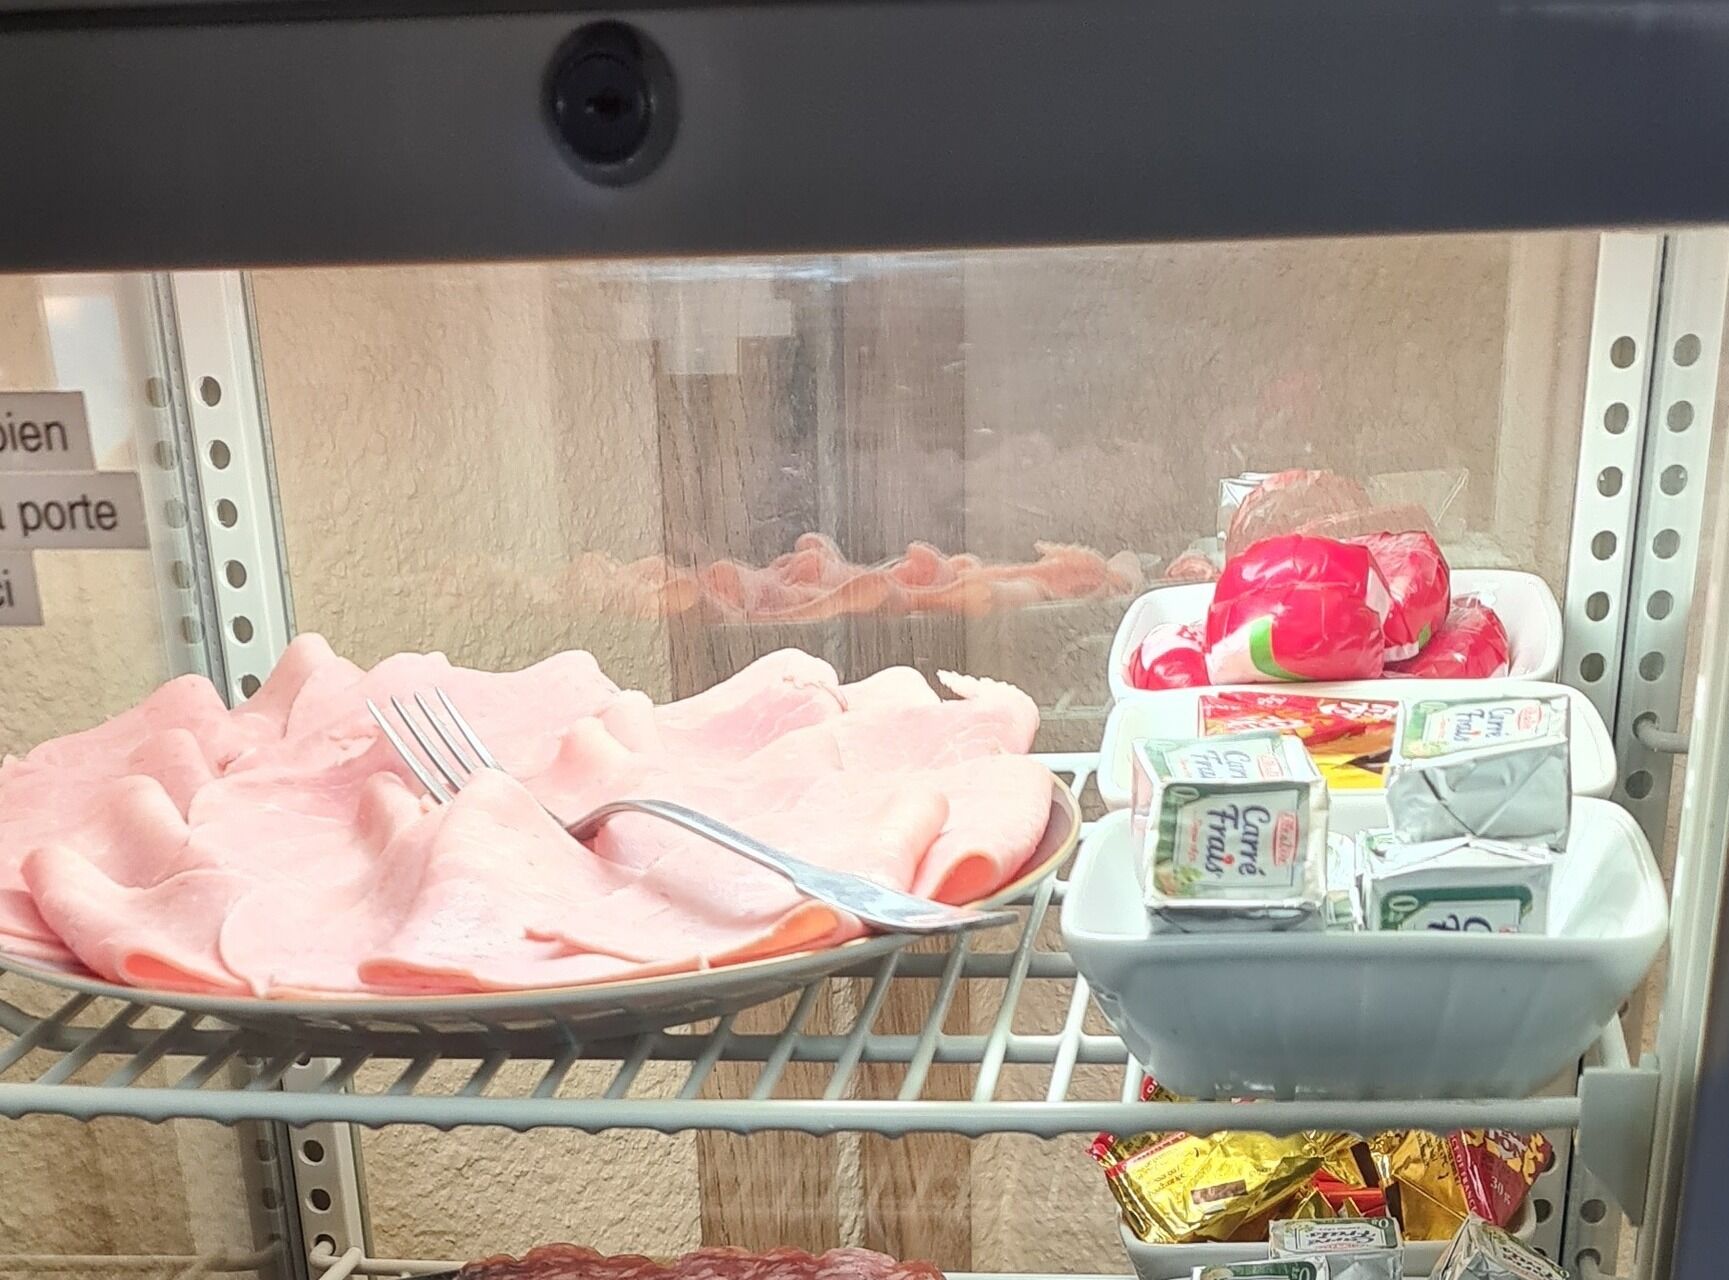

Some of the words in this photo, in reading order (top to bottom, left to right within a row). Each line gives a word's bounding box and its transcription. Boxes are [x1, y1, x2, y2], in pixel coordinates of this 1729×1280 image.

[18, 494, 117, 536] porte
[1223, 750, 1251, 779] Carr
[1205, 804, 1239, 878] Frais
[1238, 805, 1271, 877] Carré
